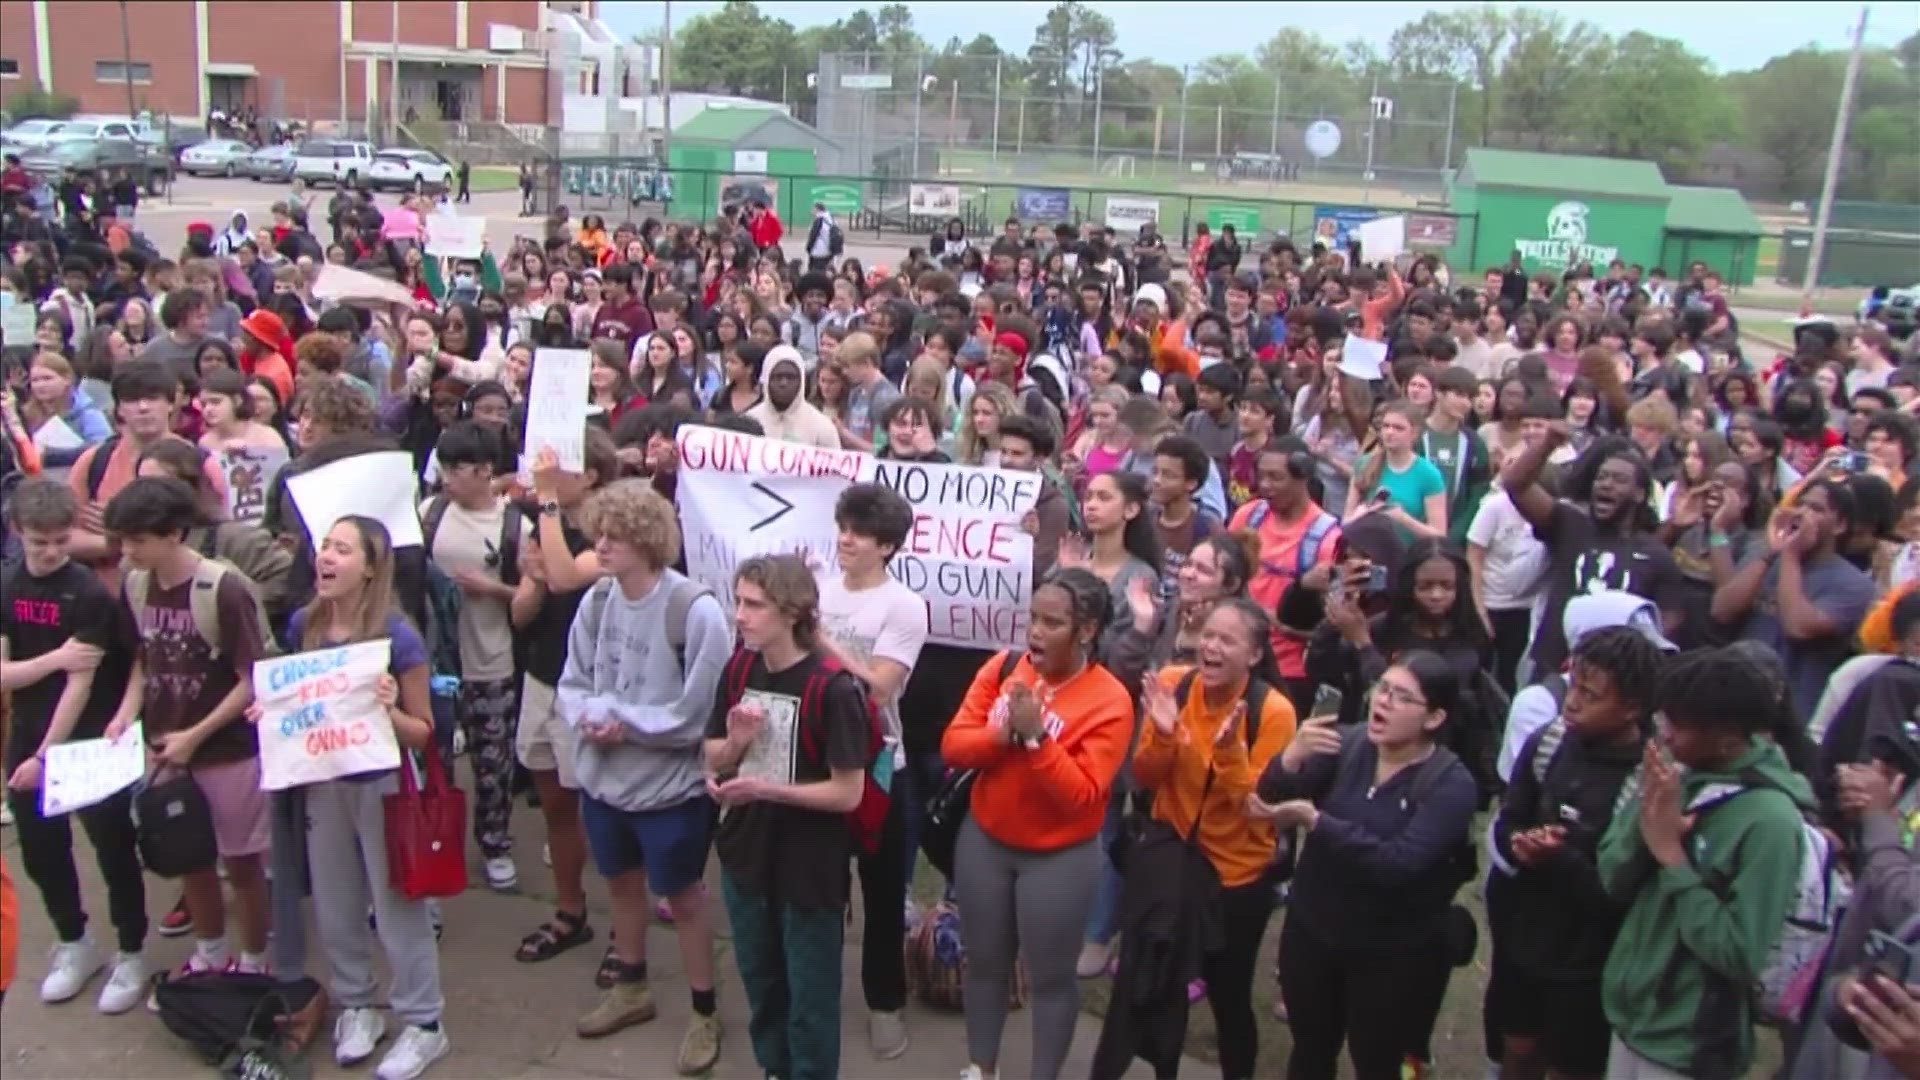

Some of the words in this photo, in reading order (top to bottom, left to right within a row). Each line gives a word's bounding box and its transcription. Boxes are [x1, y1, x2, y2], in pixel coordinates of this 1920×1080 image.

[681, 429, 750, 474] GUN
[760, 441, 862, 482] CONTROL
[875, 463, 929, 504] NO
[912, 515, 1021, 562] ENCE
[888, 555, 928, 592] ND
[938, 561, 1021, 604] GUN
[926, 600, 1028, 643] LENCE
[299, 672, 349, 704] KIDS
[280, 702, 325, 737] OVER
[306, 722, 370, 756] GUNS
